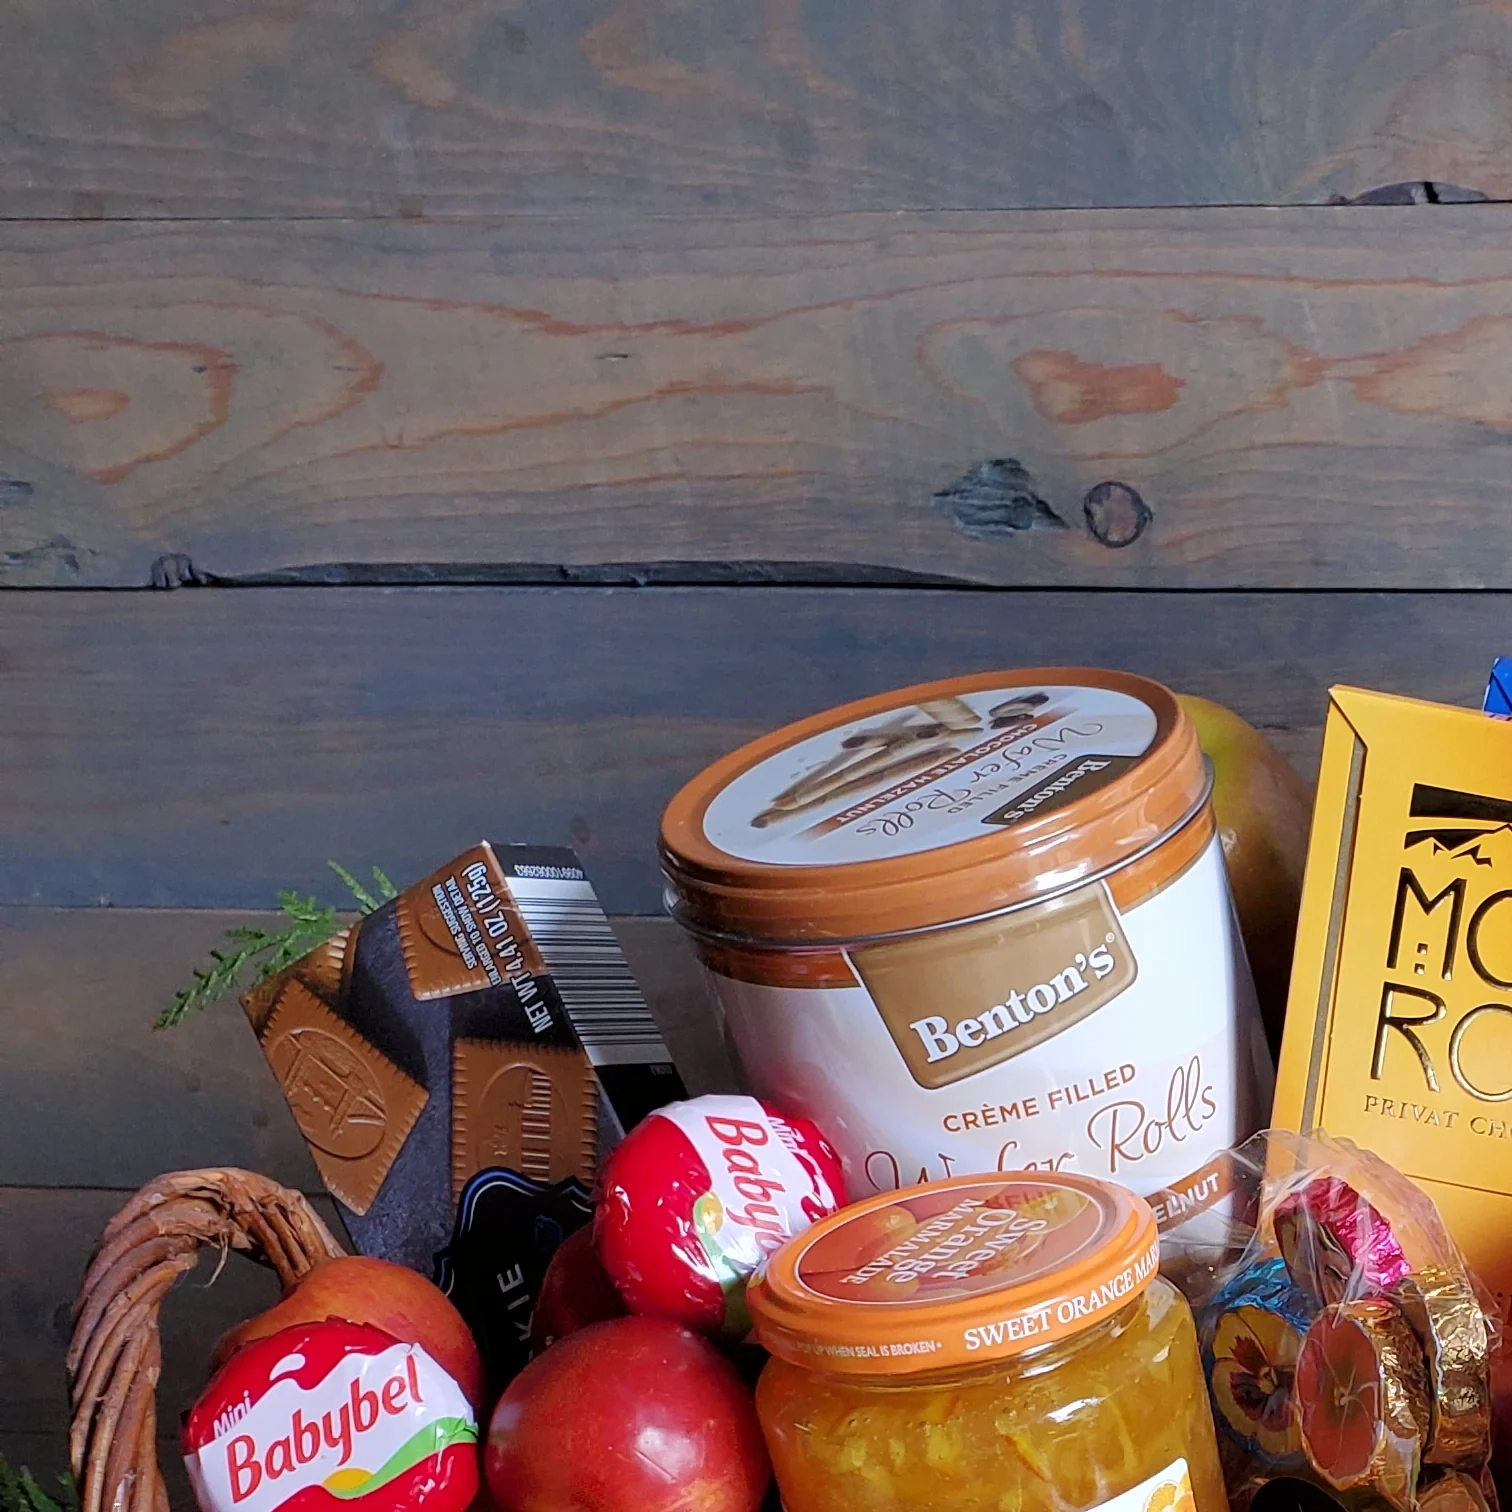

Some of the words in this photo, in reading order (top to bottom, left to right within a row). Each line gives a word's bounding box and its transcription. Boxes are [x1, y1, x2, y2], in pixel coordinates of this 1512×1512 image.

[928, 721, 1040, 776] CHOCOLATE
[964, 723, 1101, 784] Wafer
[830, 774, 933, 823] HAZELNUT
[851, 788, 976, 837] Rolls
[943, 782, 1008, 814] FILLED
[999, 759, 1113, 821] Benton's
[432, 883, 461, 932] SUGGESTION
[443, 875, 465, 905] DETAIL
[460, 860, 500, 914] (125g)
[457, 904, 477, 931] SHOW
[469, 930, 482, 943] TO
[482, 910, 509, 937] OZ
[455, 932, 477, 967] SERVING
[474, 941, 503, 985] ENLARGED
[493, 934, 526, 971] 4.41
[509, 970, 540, 1001] WT
[909, 943, 1116, 1064] Benton's
[523, 1000, 555, 1032] NET
[943, 1096, 1040, 1134] CRÈME
[1048, 1063, 1137, 1111] FILLED
[1086, 1054, 1218, 1174] Rolls
[1363, 1093, 1461, 1130] PRIVAT
[838, 1197, 984, 1286] MARMALADE
[885, 1207, 1020, 1285] Orange
[934, 1217, 1048, 1281] Sweet
[964, 1308, 1053, 1350] SWEET
[1056, 1267, 1134, 1324] ORANGE
[826, 1344, 855, 1357] WHEN
[855, 1344, 880, 1358] SEAL
[880, 1343, 890, 1357] IS
[891, 1340, 936, 1357] BROKEN
[213, 1390, 252, 1440] Mini
[226, 1354, 425, 1504] Babybel
